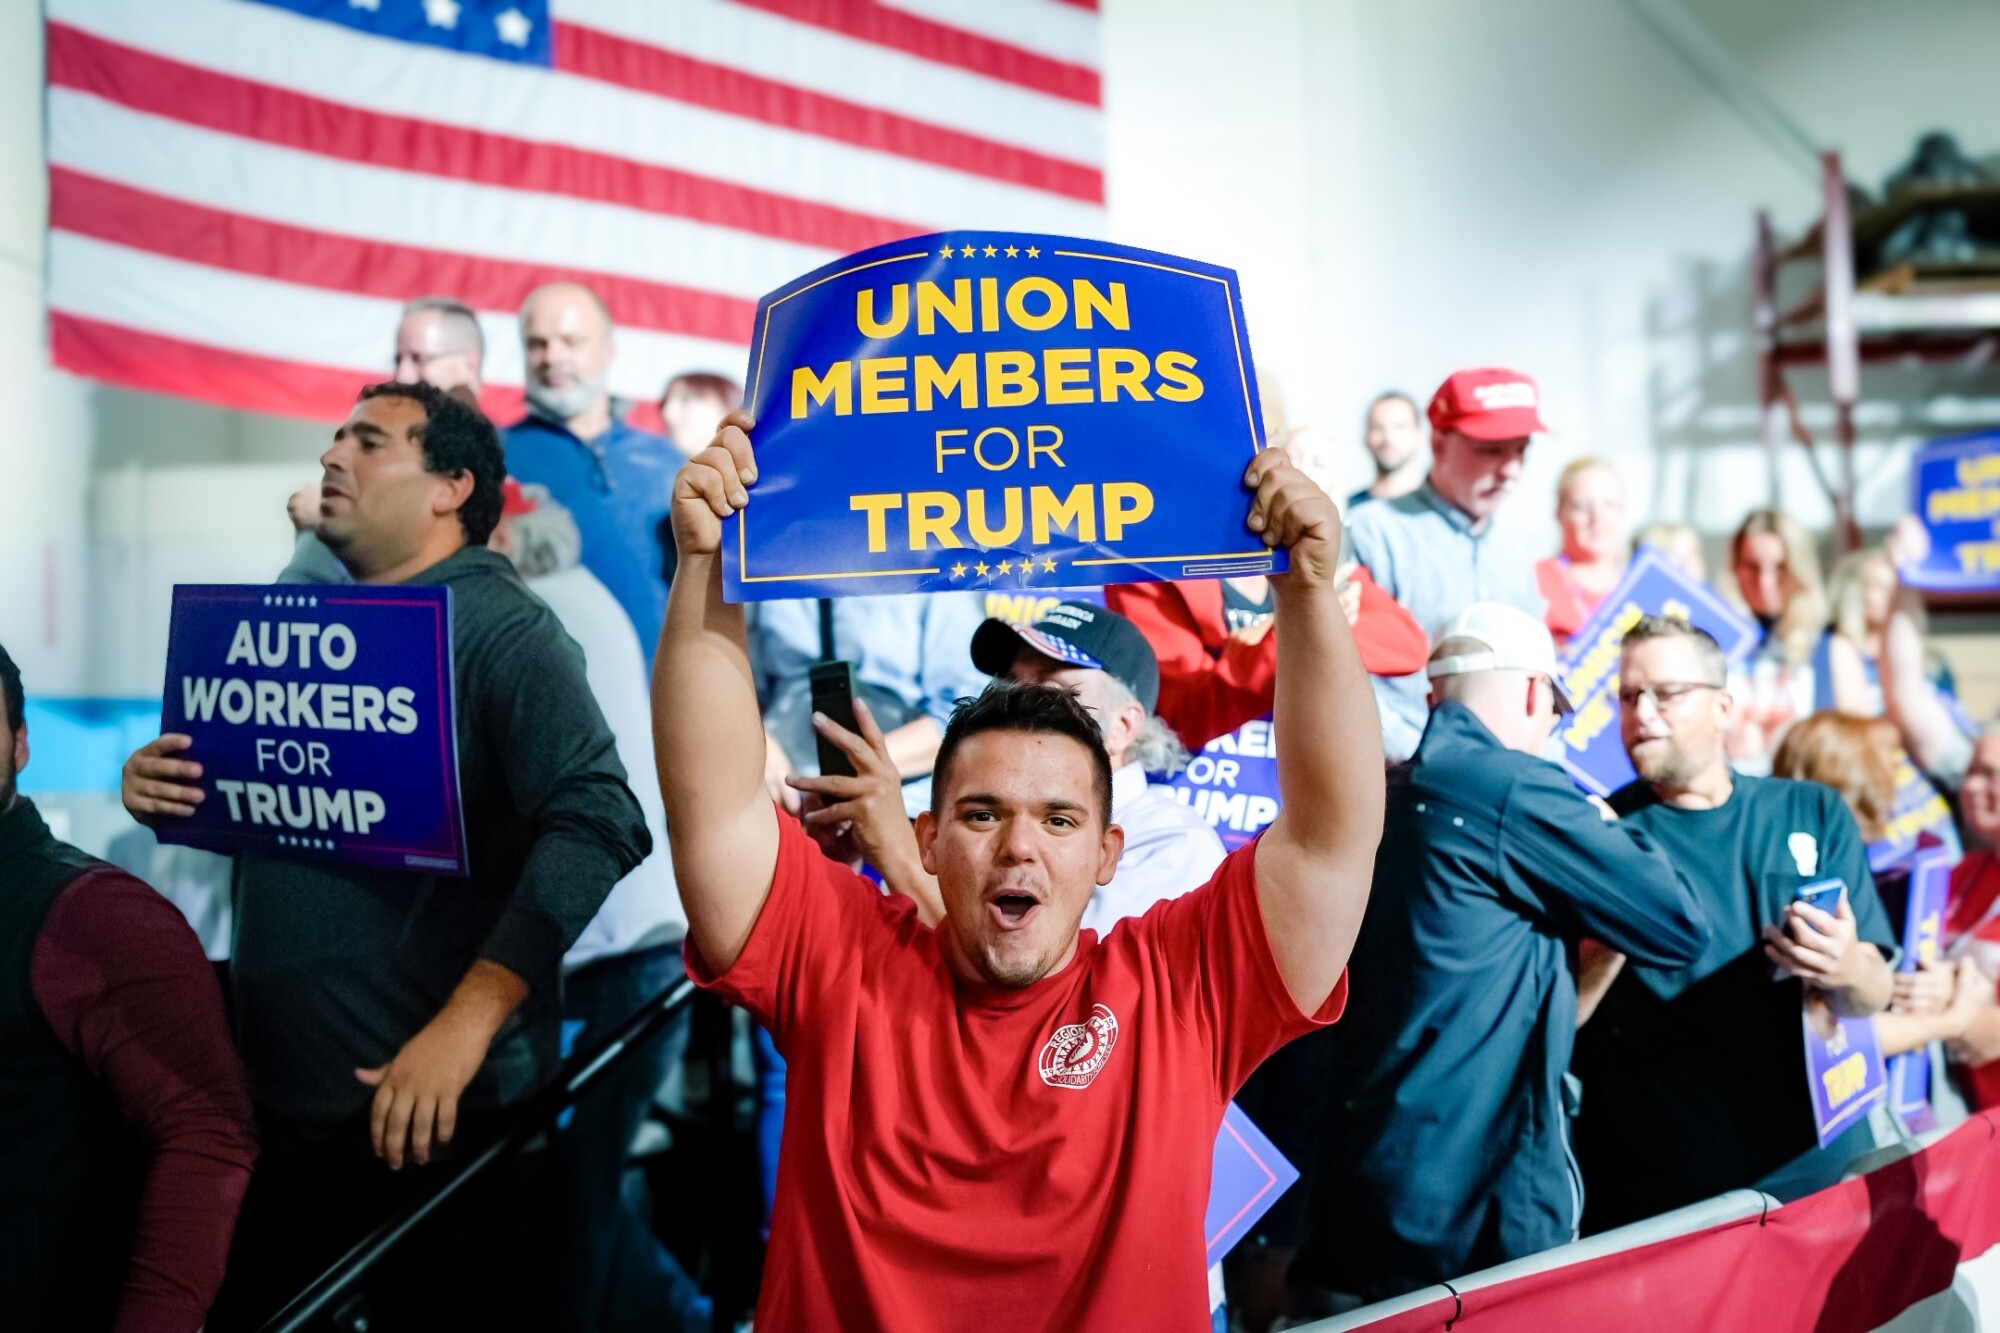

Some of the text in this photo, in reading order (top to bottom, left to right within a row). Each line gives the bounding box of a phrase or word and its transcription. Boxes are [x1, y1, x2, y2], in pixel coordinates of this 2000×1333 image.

[856, 276, 1130, 339] UNION
[790, 348, 1205, 419] MEMBERS
[934, 424, 1065, 474] FOR
[849, 481, 1154, 553] TRUMP
[225, 620, 357, 671] AUTO
[182, 675, 418, 735] WORKERS
[256, 738, 332, 777] FOR
[1185, 755, 1241, 789] OR
[215, 779, 386, 834] TRUMP
[1050, 1026, 1087, 1049] REGION
[1104, 1018, 1114, 1029] 39
[1044, 1069, 1055, 1078] 19
